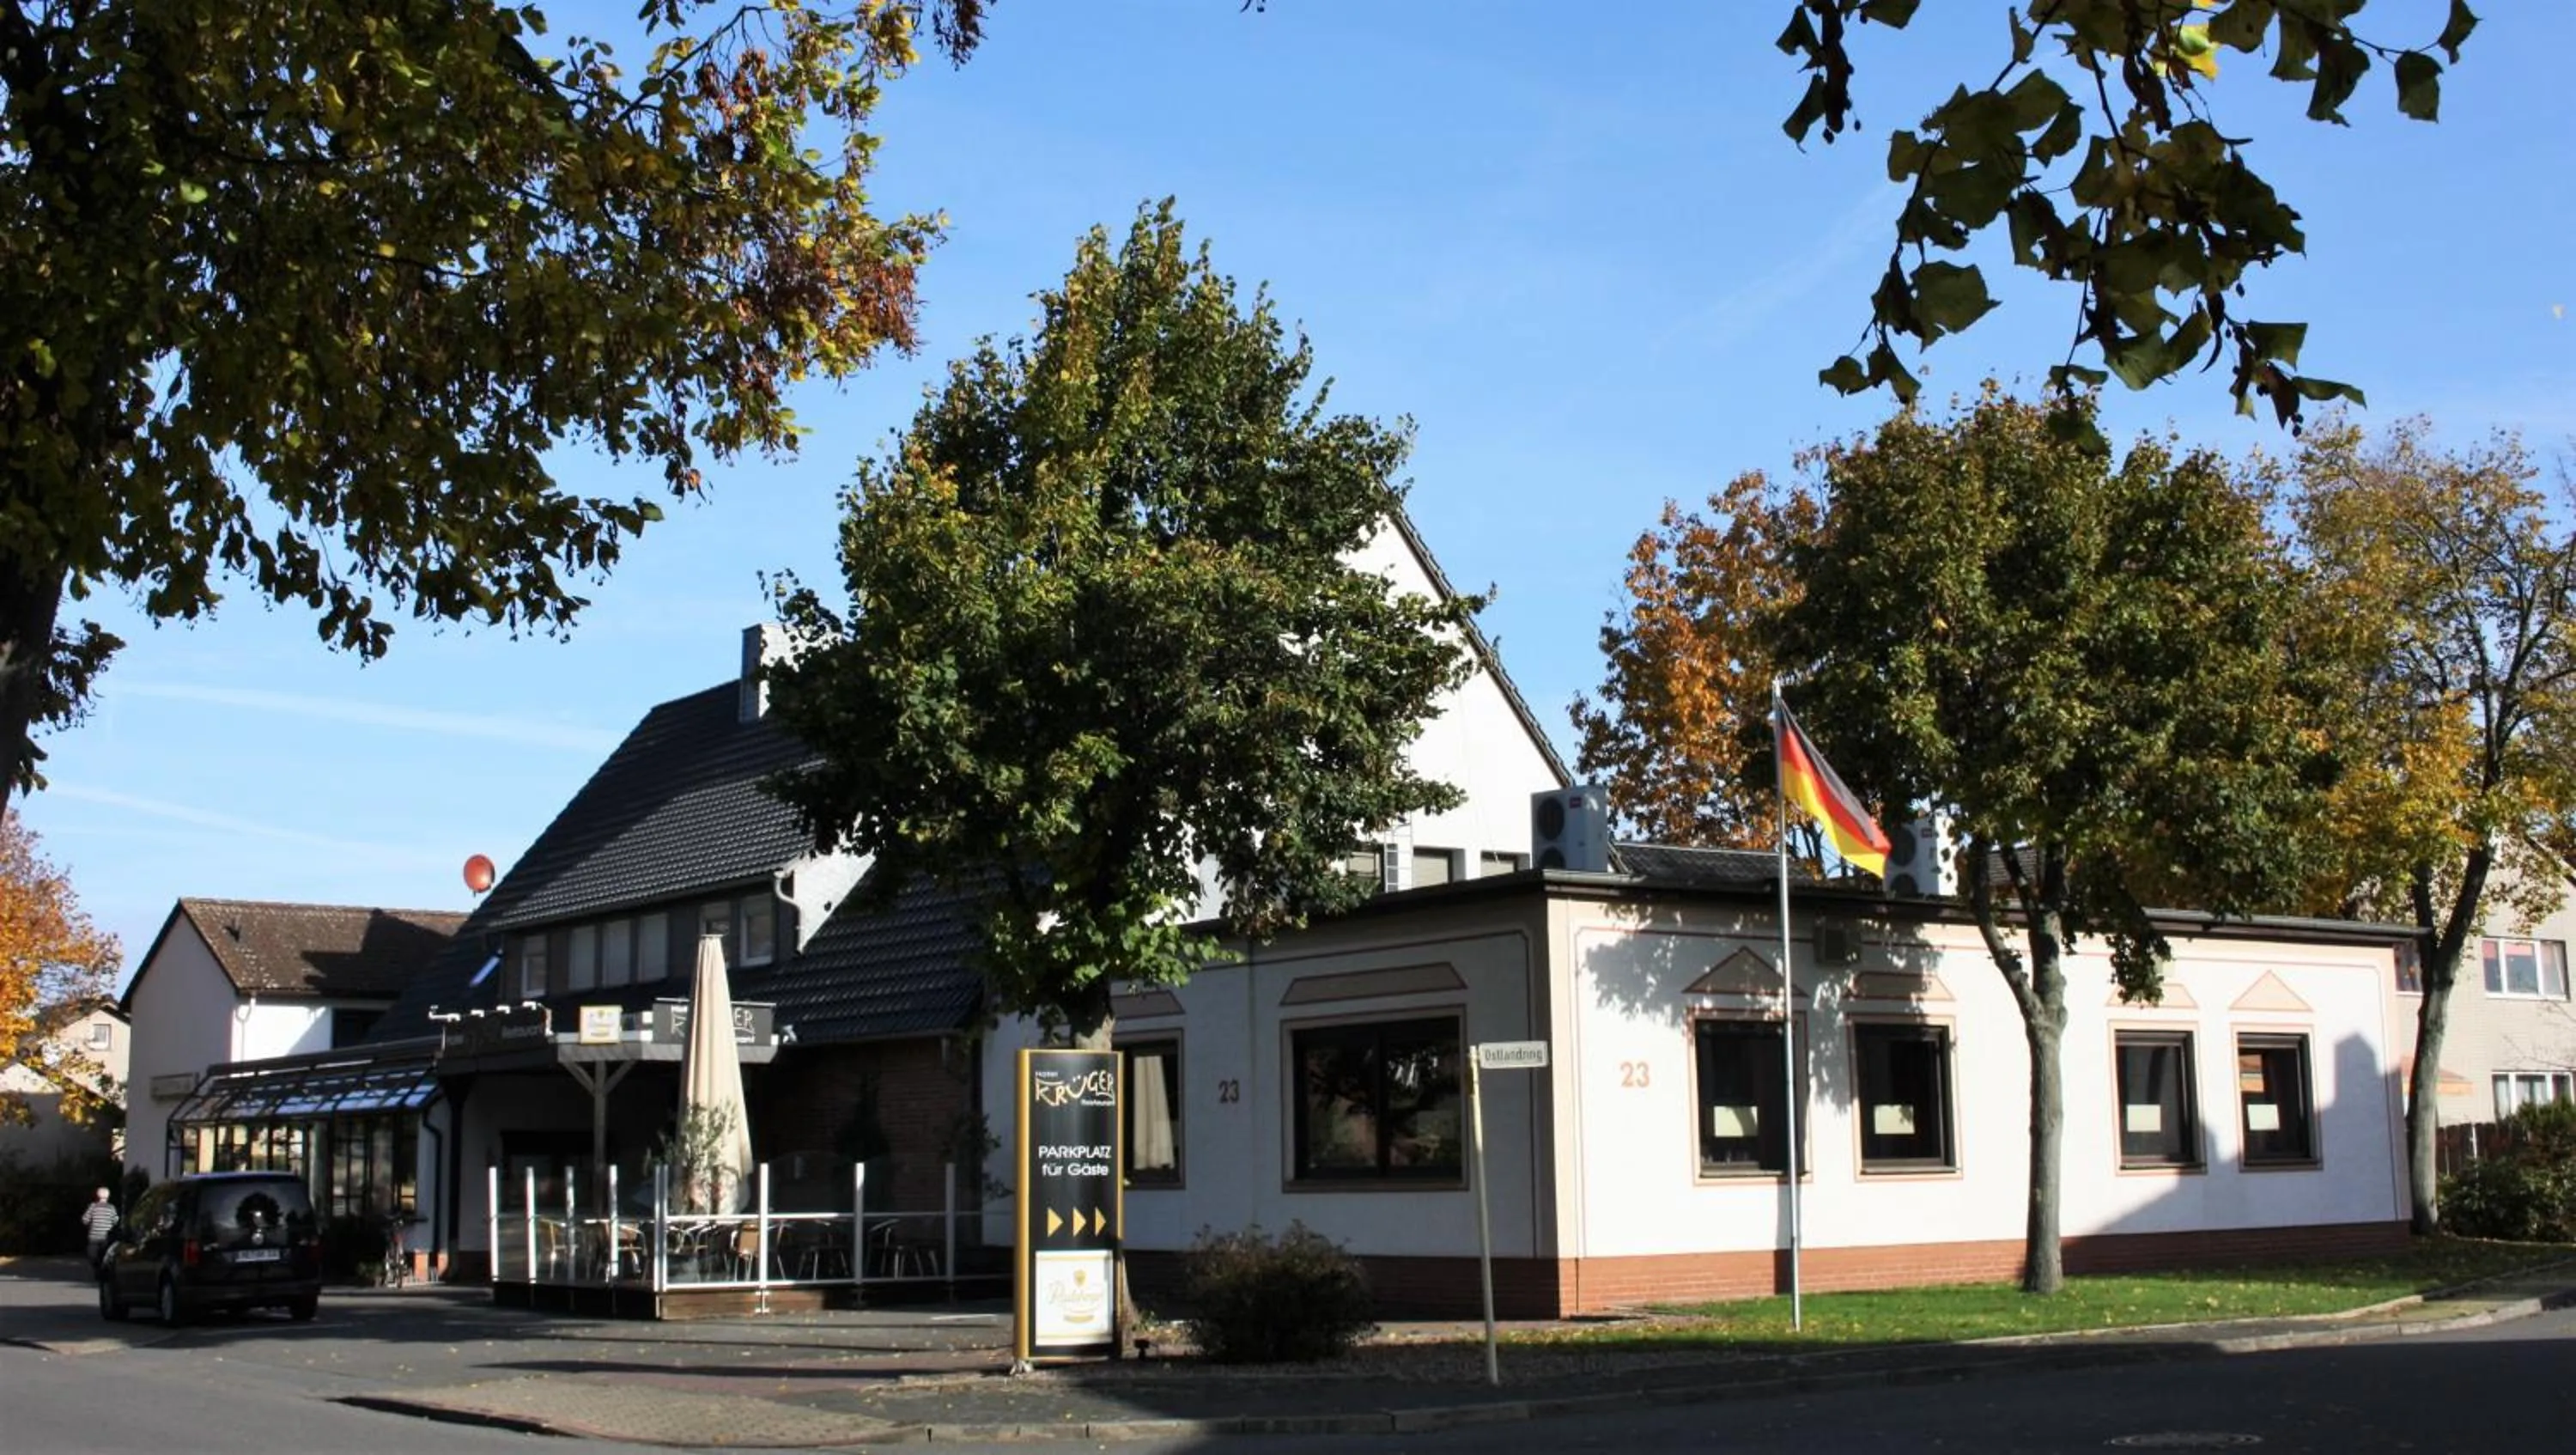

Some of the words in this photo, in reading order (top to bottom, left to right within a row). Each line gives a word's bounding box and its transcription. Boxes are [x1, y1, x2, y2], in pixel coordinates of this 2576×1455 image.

[1620, 1062, 1650, 1088] 23
[1035, 1070, 1115, 1106] KRÜGER
[1218, 1080, 1240, 1104] 23
[1038, 1145, 1112, 1159] PARKPLATZ
[1042, 1162, 1064, 1177] für
[1067, 1162, 1109, 1176] Gäste
